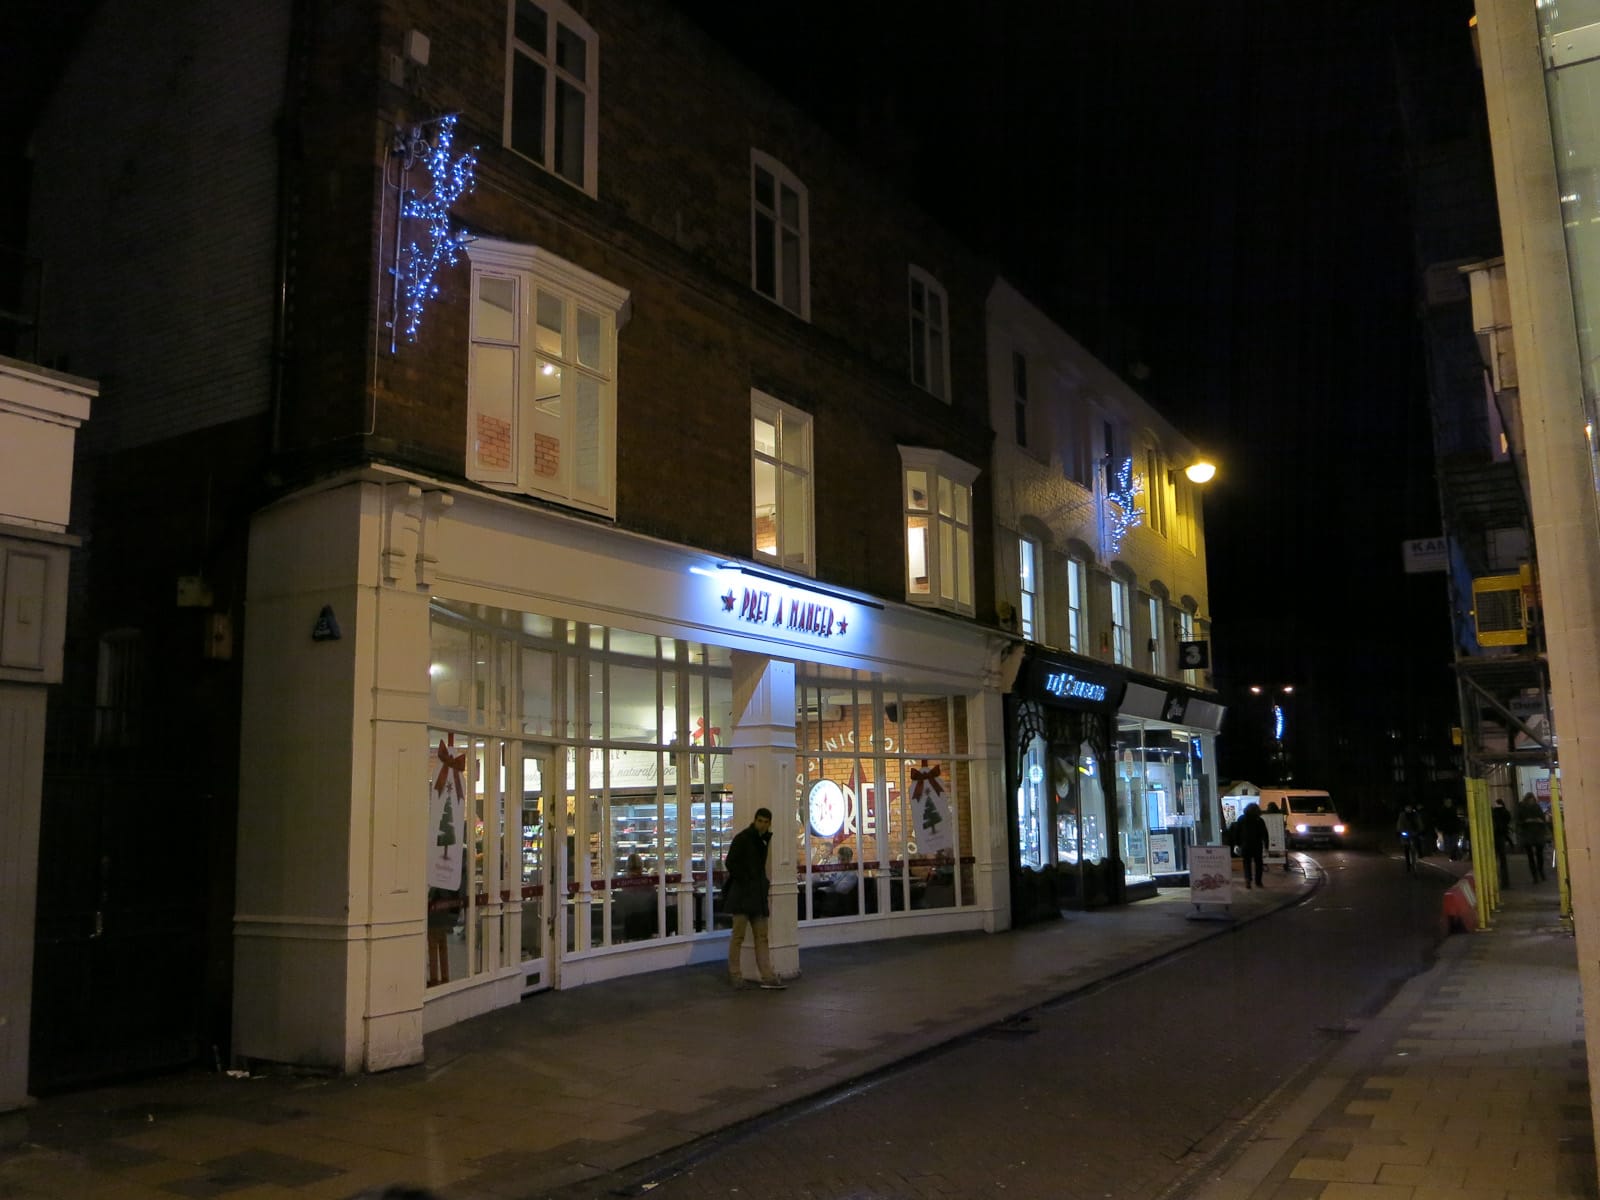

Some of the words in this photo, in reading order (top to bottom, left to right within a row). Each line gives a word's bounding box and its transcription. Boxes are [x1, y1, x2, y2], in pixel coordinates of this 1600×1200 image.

[741, 587, 771, 621] PRET
[775, 596, 783, 625] A
[789, 599, 834, 635] MANGER
[1185, 645, 1201, 665] 3
